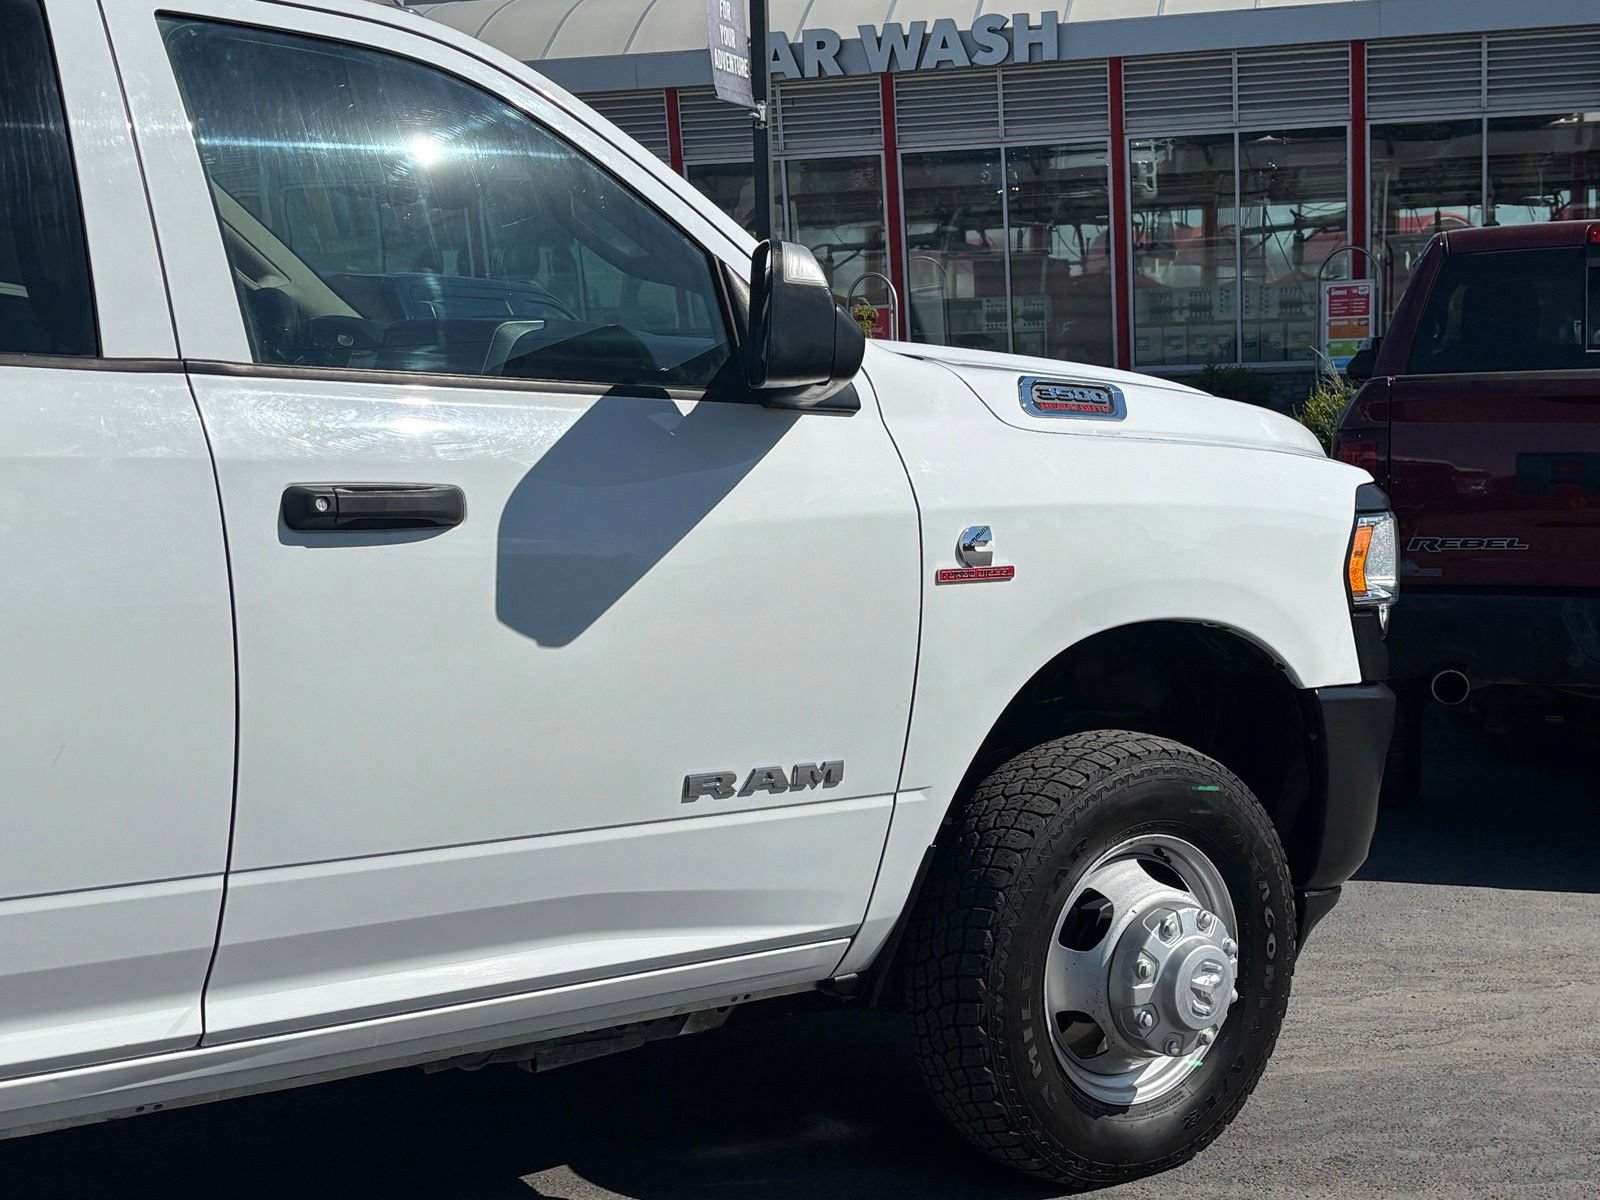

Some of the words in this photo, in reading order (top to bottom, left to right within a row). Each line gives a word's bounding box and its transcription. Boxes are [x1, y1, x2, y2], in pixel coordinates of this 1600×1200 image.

[719, 0, 732, 21] FOR
[719, 23, 736, 49] YOUR
[768, 28, 844, 80] AR
[857, 11, 1058, 73] WASH
[714, 47, 749, 79] ADVENTURE
[1035, 386, 1107, 404] 3500
[1407, 537, 1529, 552] REBEL
[681, 760, 844, 804] RAM
